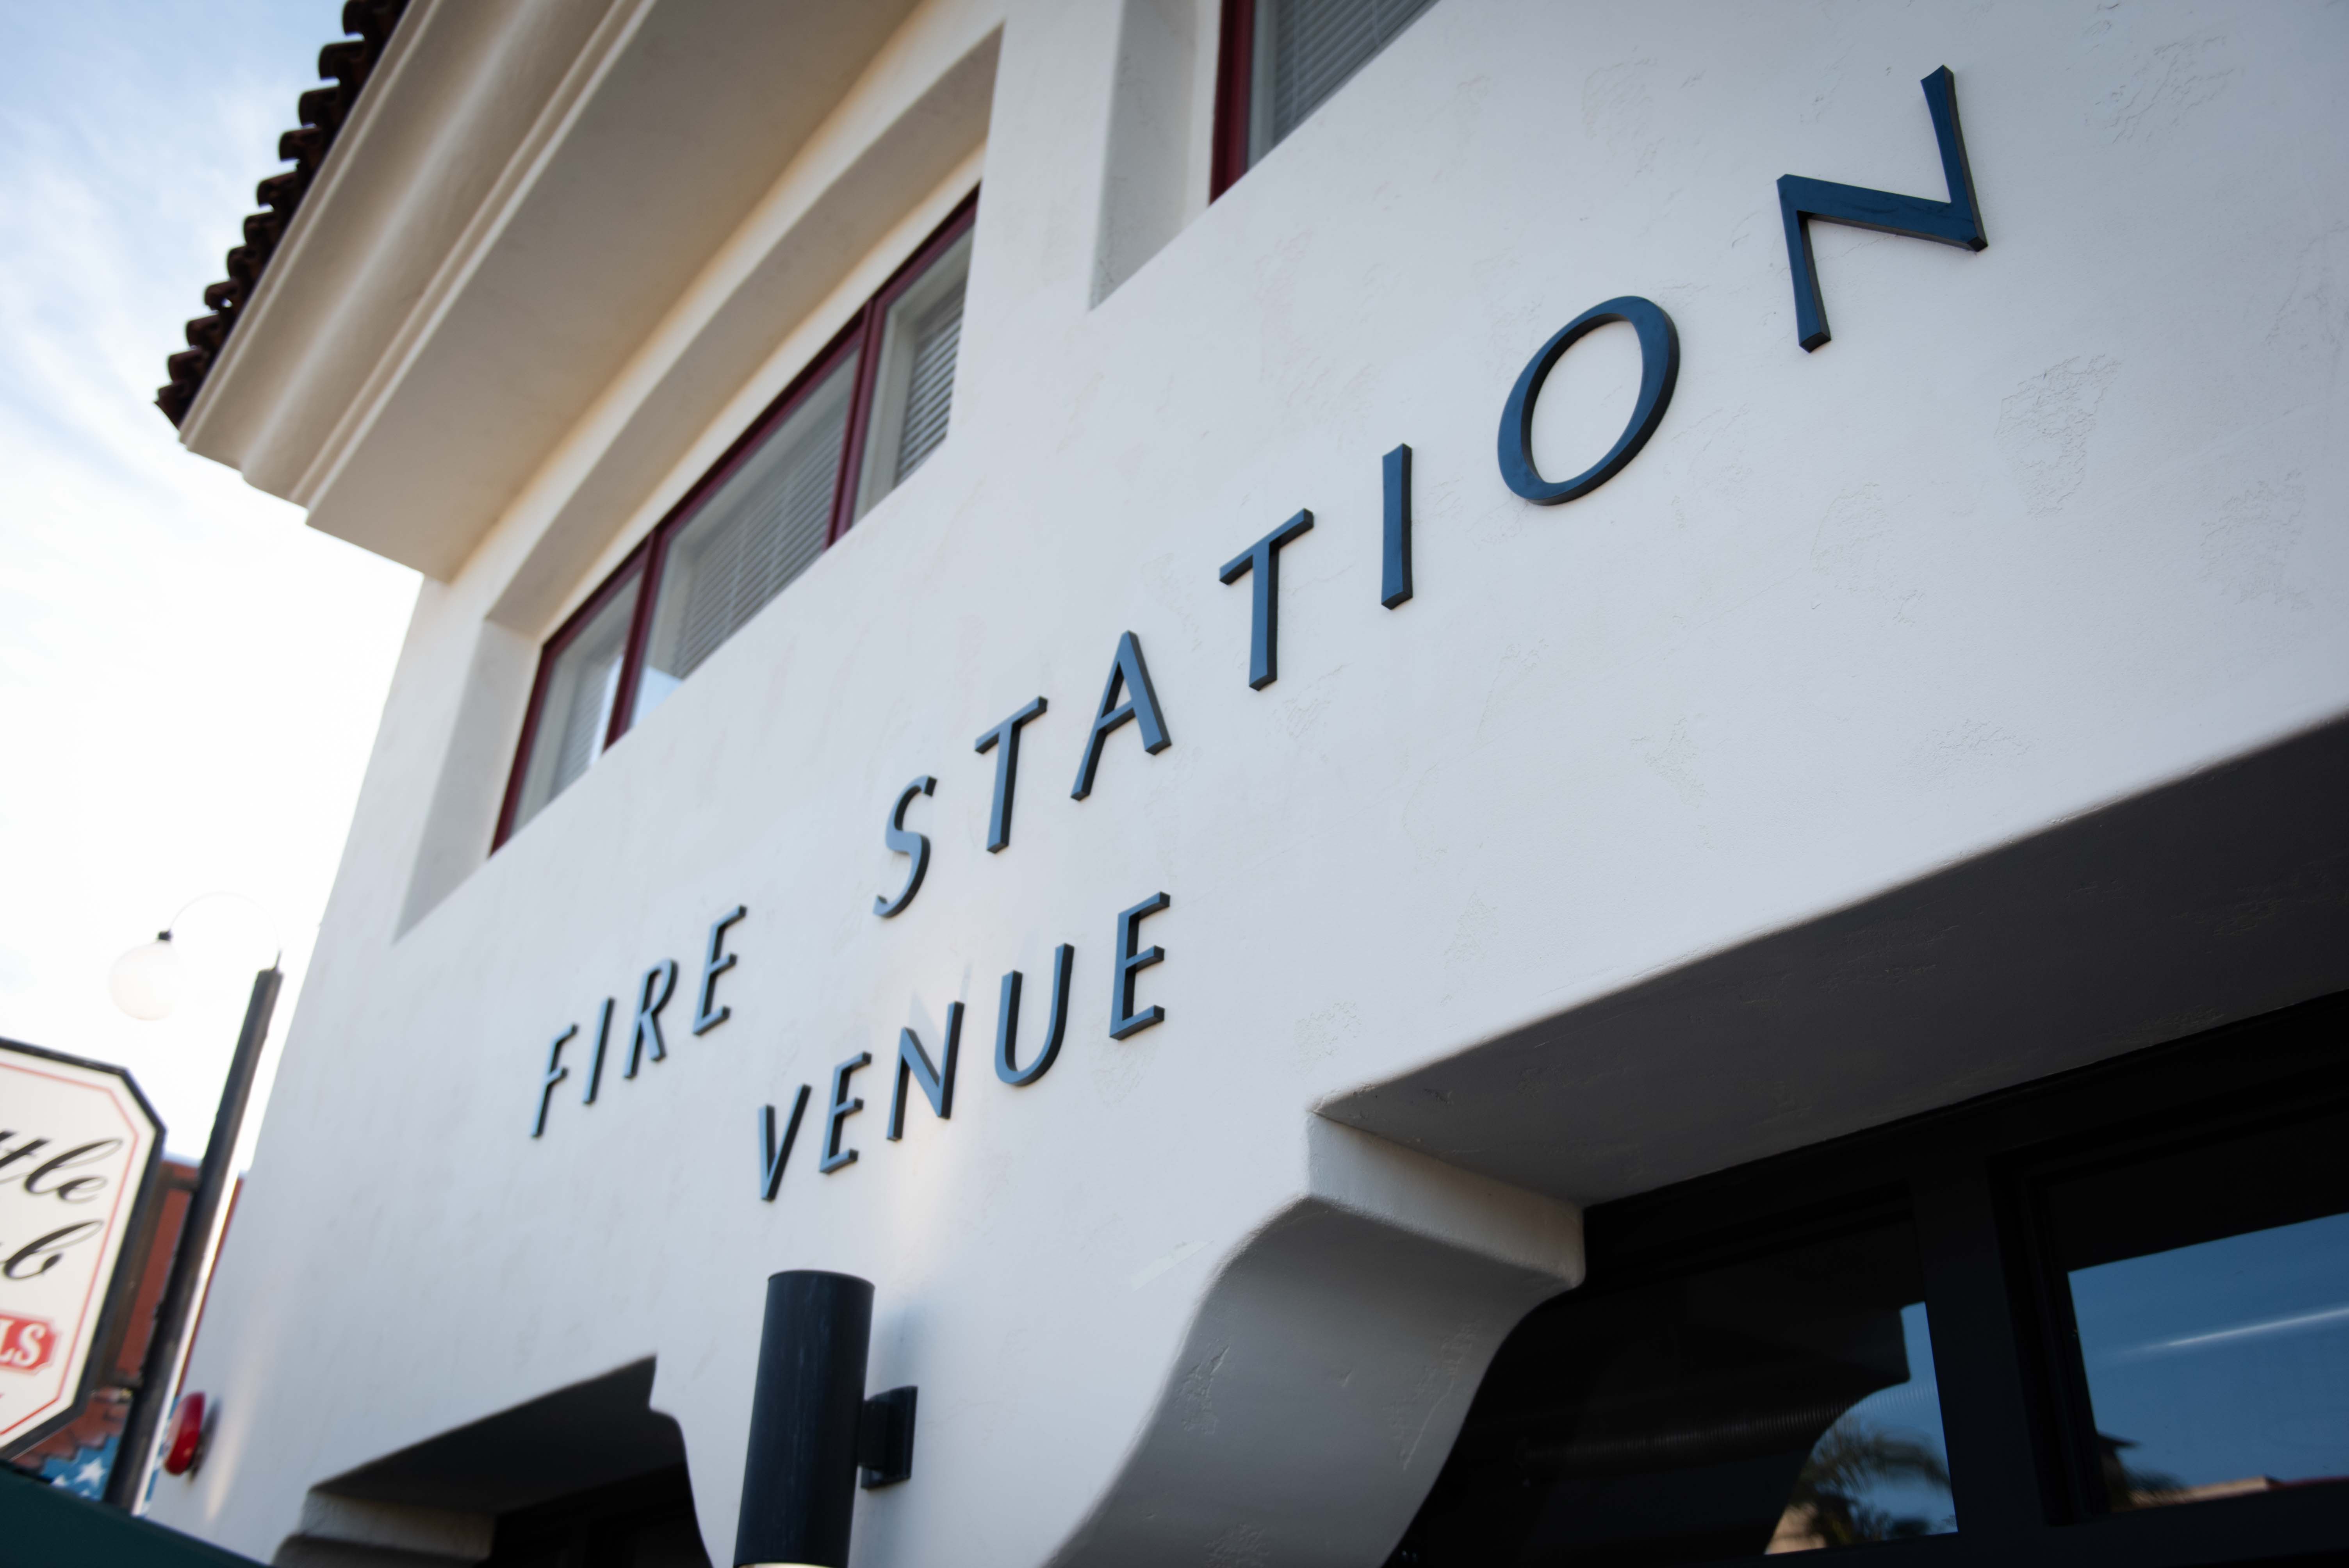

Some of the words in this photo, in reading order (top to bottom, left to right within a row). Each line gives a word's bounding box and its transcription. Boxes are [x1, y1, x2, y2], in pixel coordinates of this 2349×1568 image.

[530, 904, 747, 1140] FIRE
[873, 64, 1990, 920] STATION
[758, 891, 1171, 1204] VENUE
